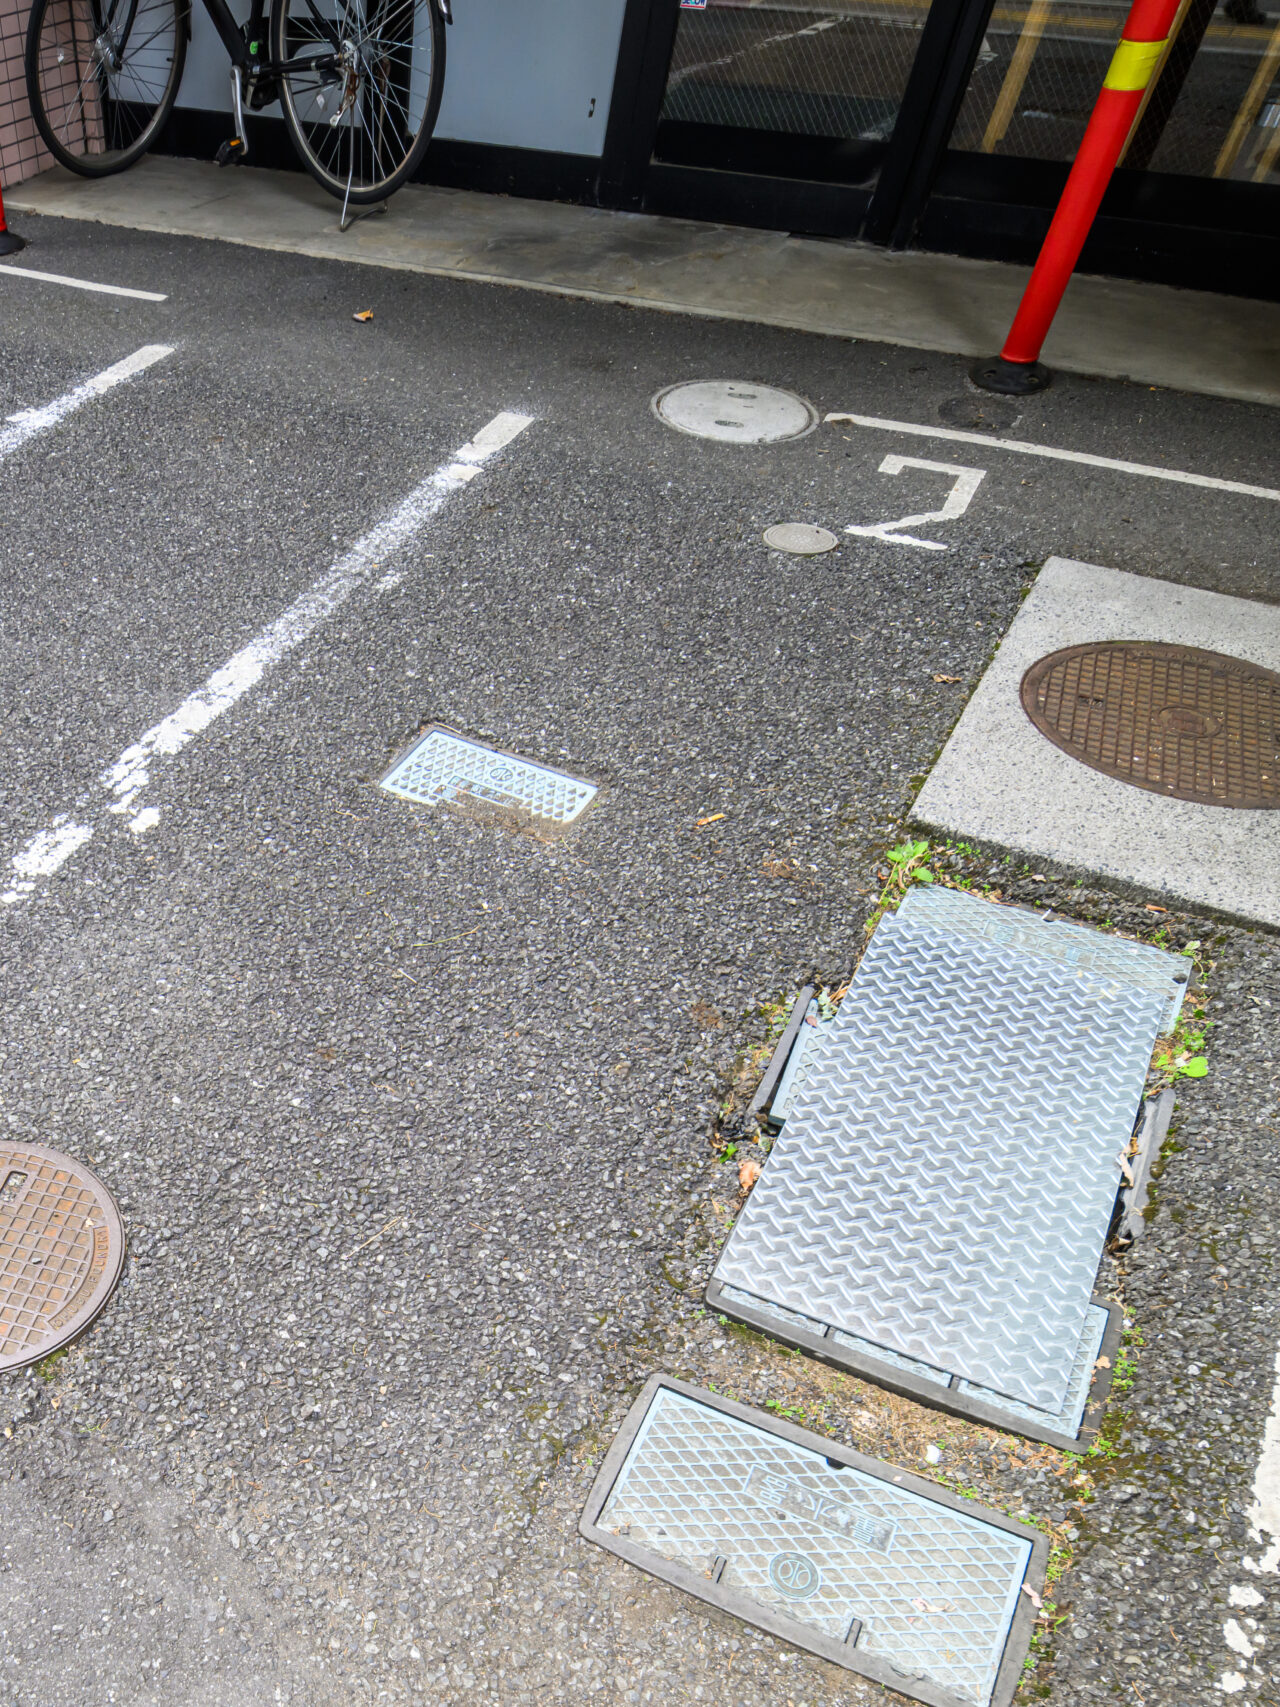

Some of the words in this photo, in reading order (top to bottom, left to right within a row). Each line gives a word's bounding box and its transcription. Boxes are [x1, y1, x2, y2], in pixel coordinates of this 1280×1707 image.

[844, 454, 987, 550] 2
[759, 1474, 877, 1545] 量水器
